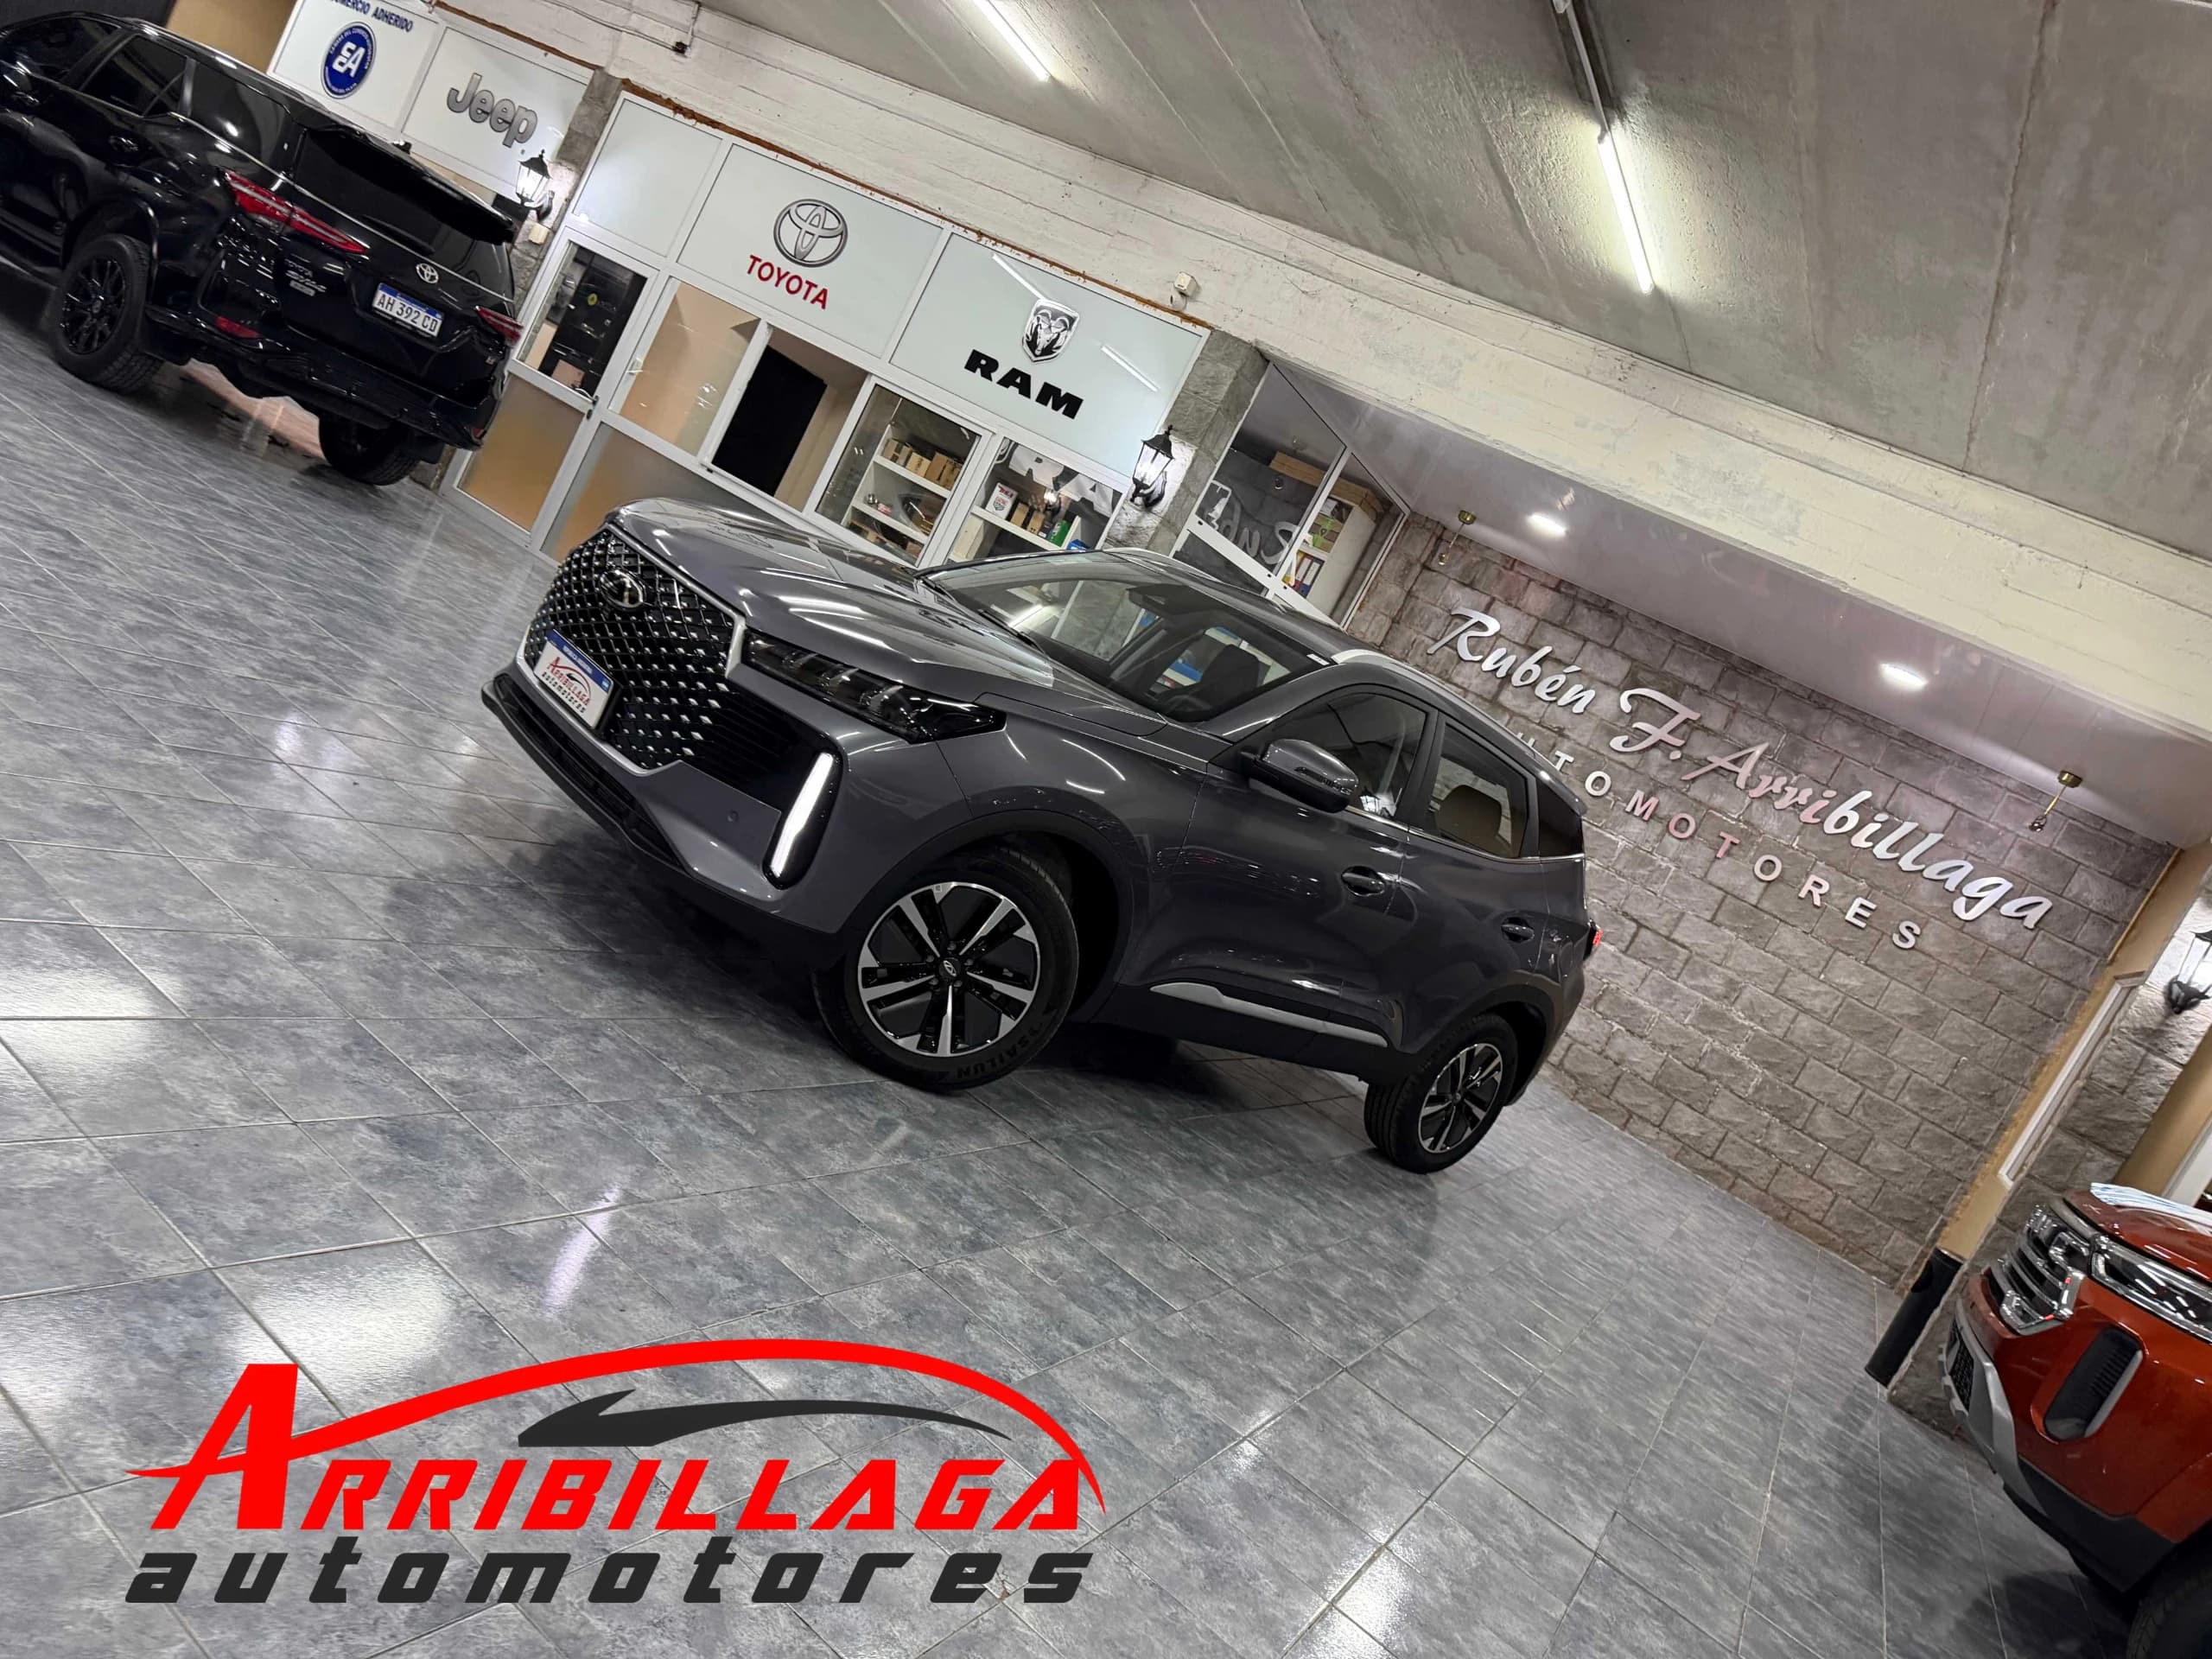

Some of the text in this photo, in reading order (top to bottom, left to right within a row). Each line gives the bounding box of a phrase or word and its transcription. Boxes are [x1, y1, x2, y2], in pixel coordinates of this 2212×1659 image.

[330, 0, 413, 33] ERCIO ADHERIDO
[447, 72, 537, 148] Jeep
[377, 294, 396, 312] AH
[396, 302, 421, 324] 392
[747, 254, 829, 309] TOYOTA
[964, 348, 1084, 419] RAM
[1427, 607, 1596, 714] Rubén
[1516, 732, 1922, 949] TOMOTORES
